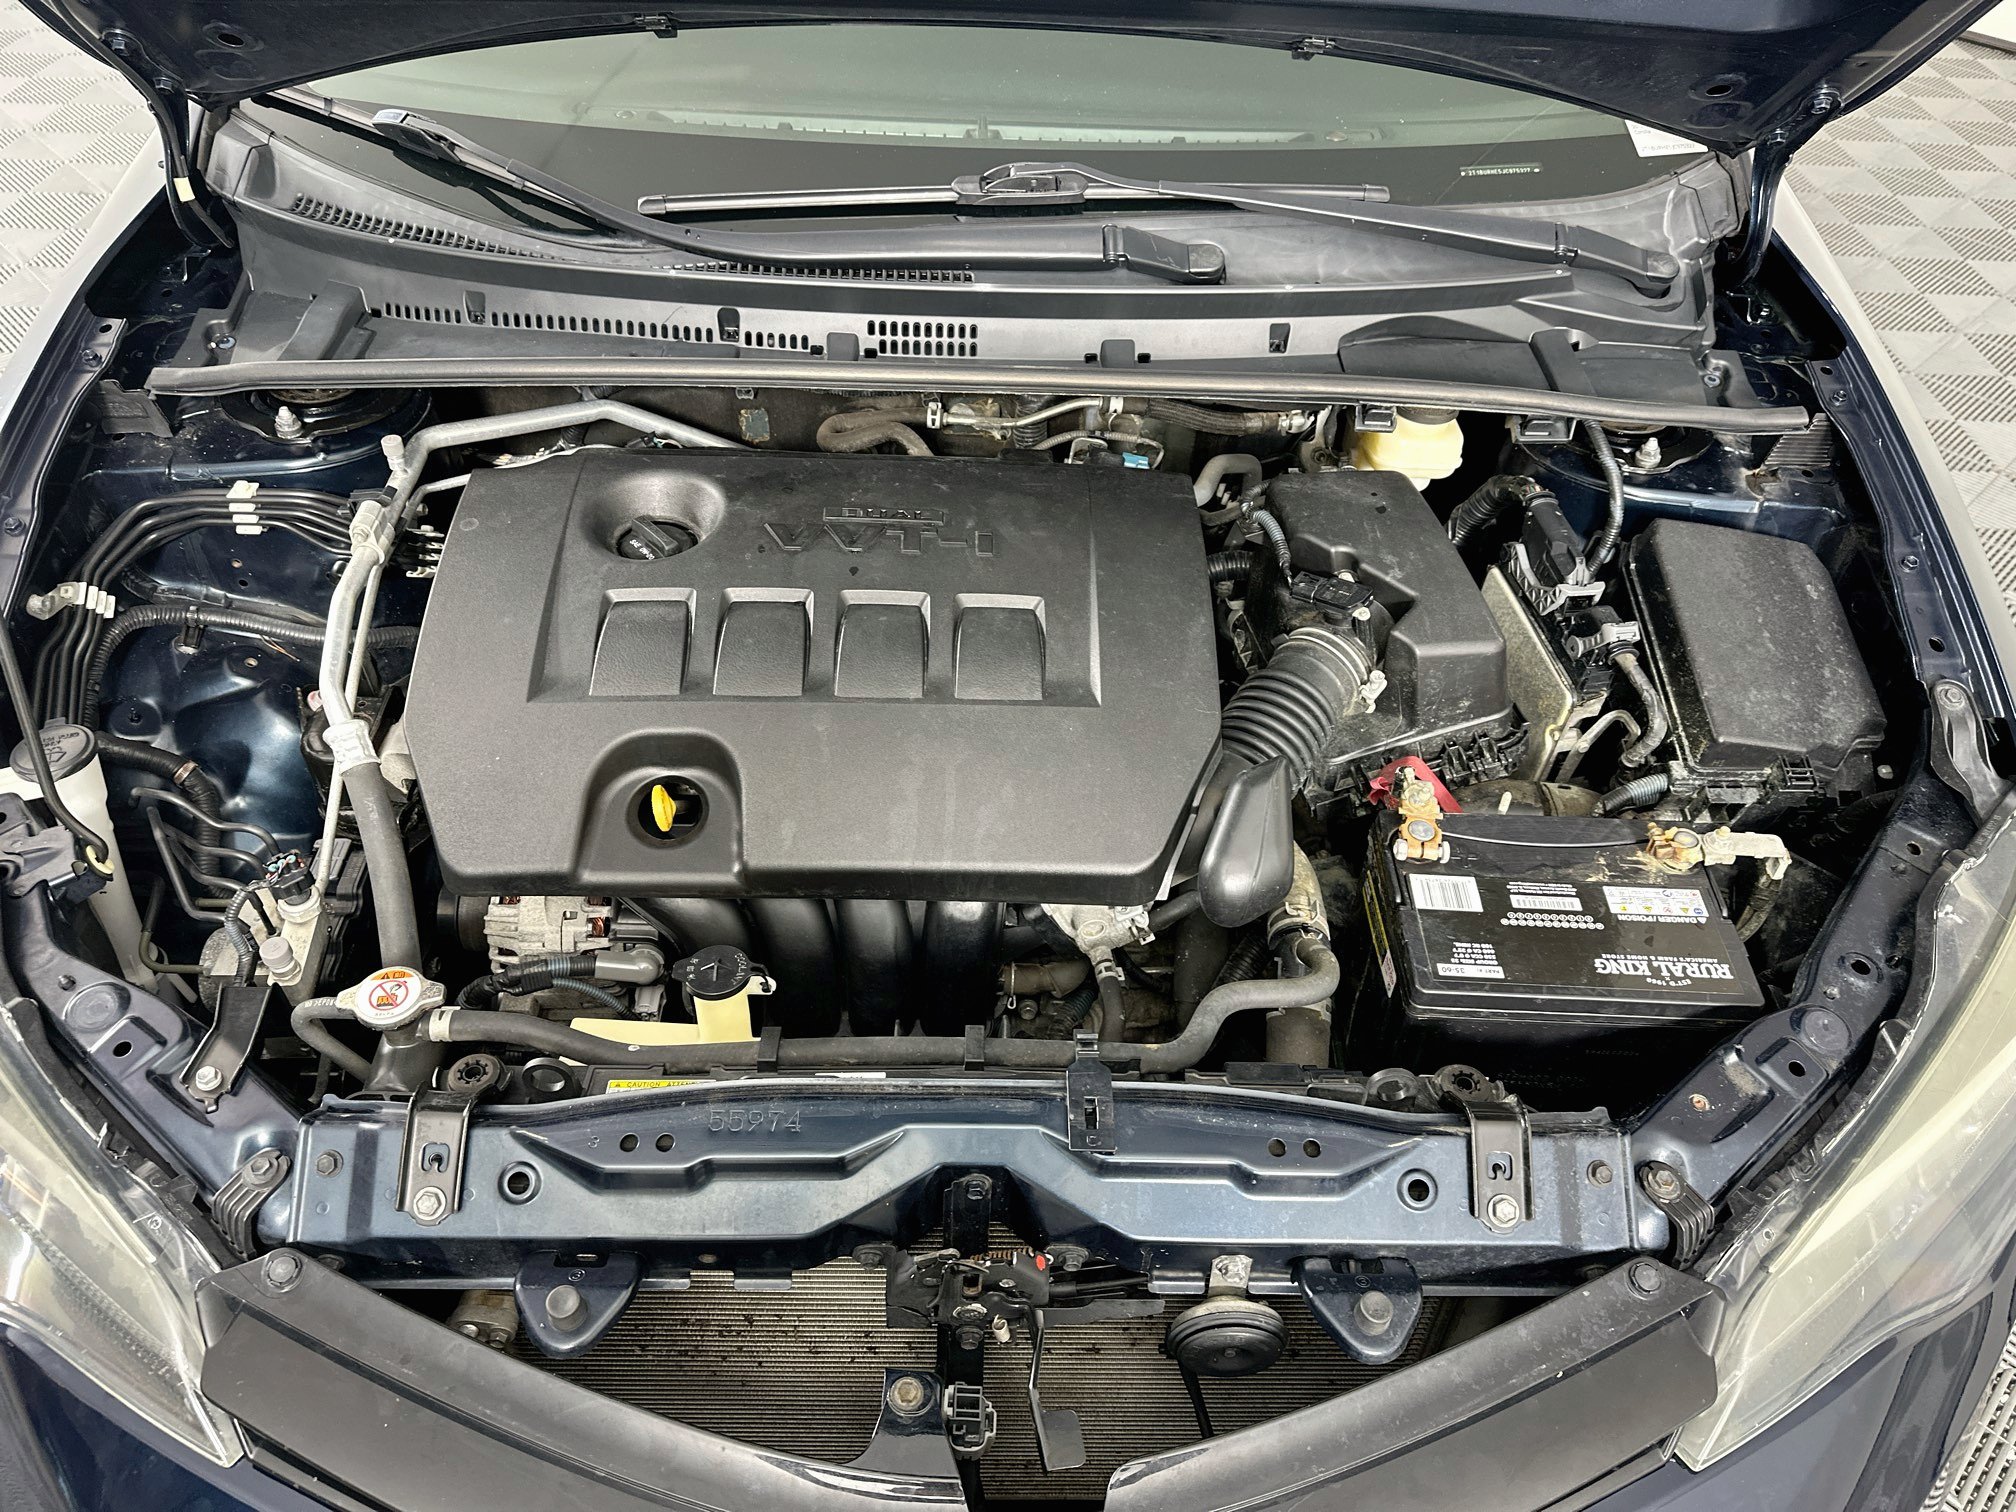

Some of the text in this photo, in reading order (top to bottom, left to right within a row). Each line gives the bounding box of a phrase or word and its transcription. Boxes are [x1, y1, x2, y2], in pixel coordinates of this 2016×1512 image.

[1441, 966, 1465, 974] 35-60
[1594, 958, 1734, 980] RURAL KING
[708, 1109, 802, 1133] 55974
